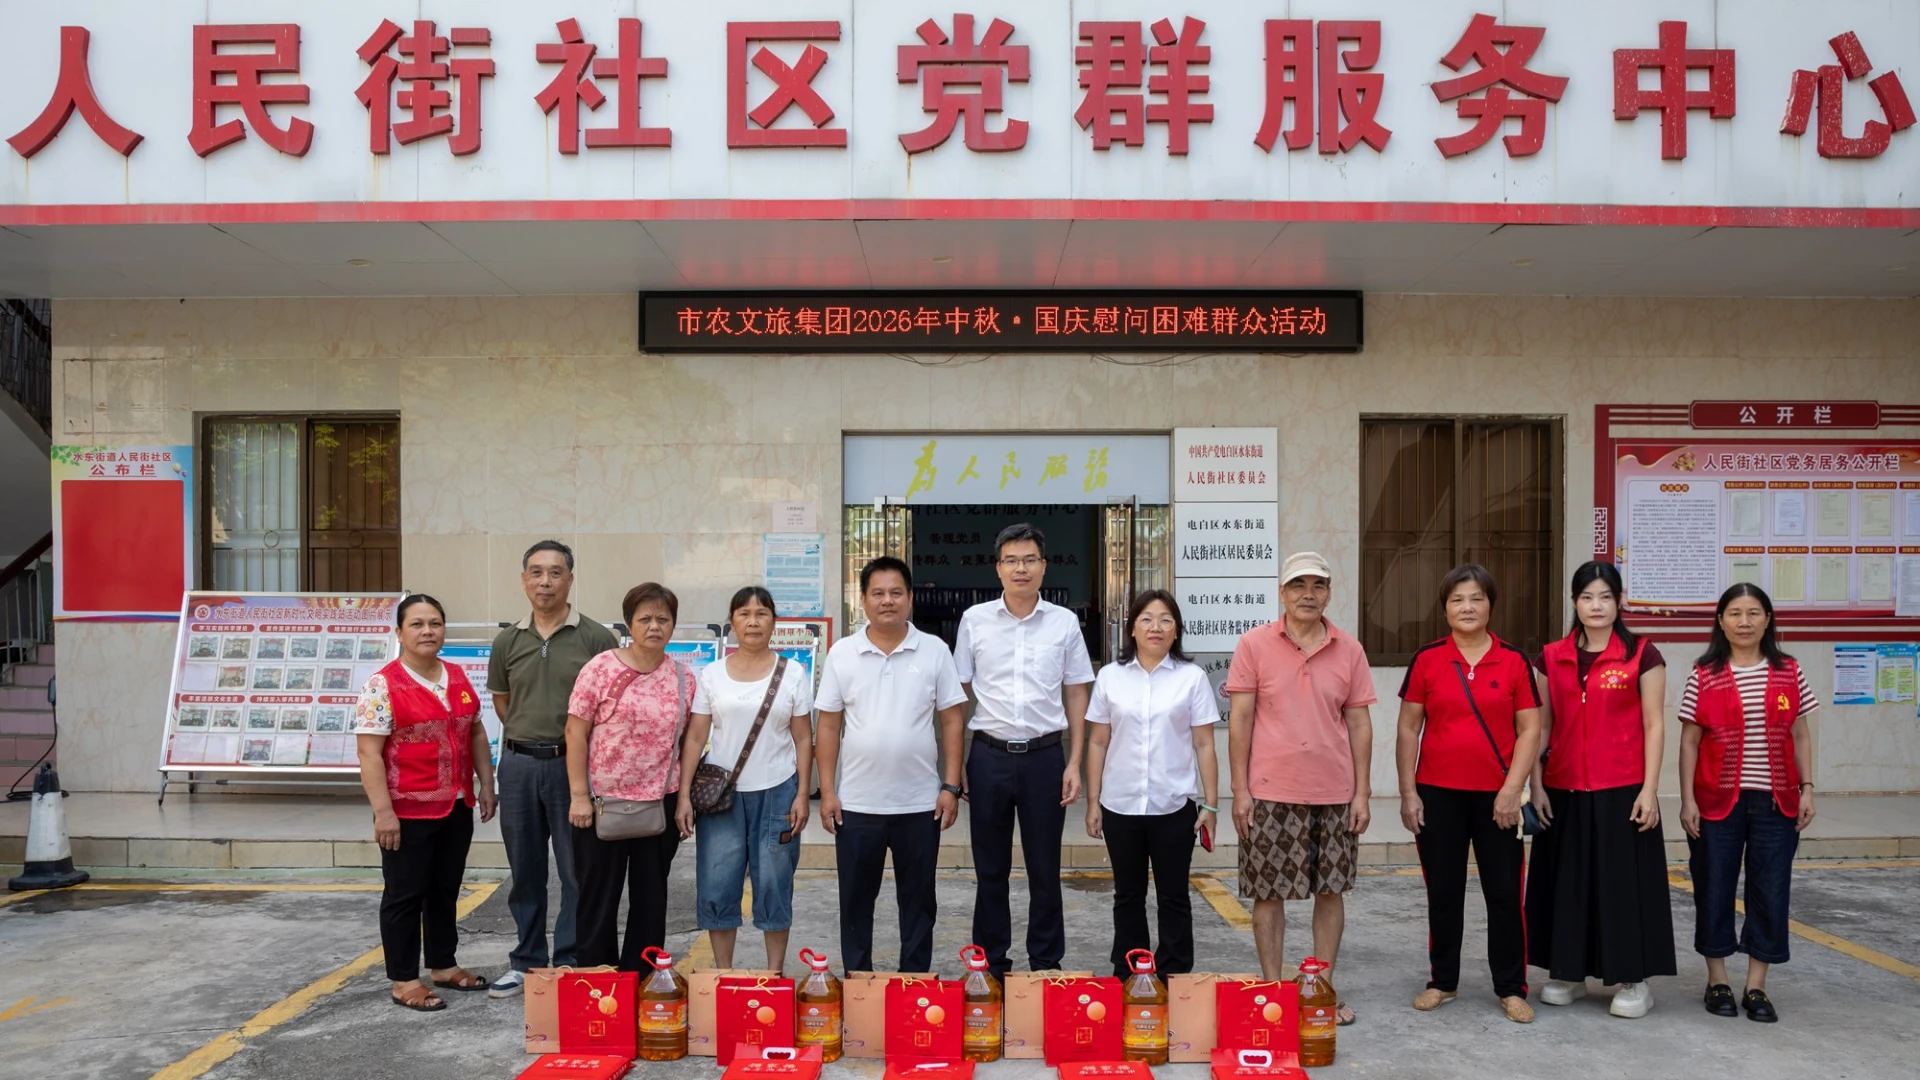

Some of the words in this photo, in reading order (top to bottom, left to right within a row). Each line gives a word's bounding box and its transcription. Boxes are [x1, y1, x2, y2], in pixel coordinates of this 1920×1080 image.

[6, 13, 1917, 160] 人民街社区党群服务中心
[1739, 405, 1832, 424] 公开栏
[73, 452, 172, 462] 水东街道人民街社区
[1188, 444, 1264, 458] 中国共产党电白区水东街道
[1704, 453, 1899, 471] 人民街社区党务居务公开栏
[90, 464, 156, 476] 公布栏
[1187, 471, 1266, 484] 人民街社区委员会
[1187, 519, 1265, 530] 电白区水东街道
[1182, 544, 1273, 560] 人民街社区居民委员会
[1046, 554, 1079, 566] 群众
[1188, 593, 1266, 605] 电白区水东街道
